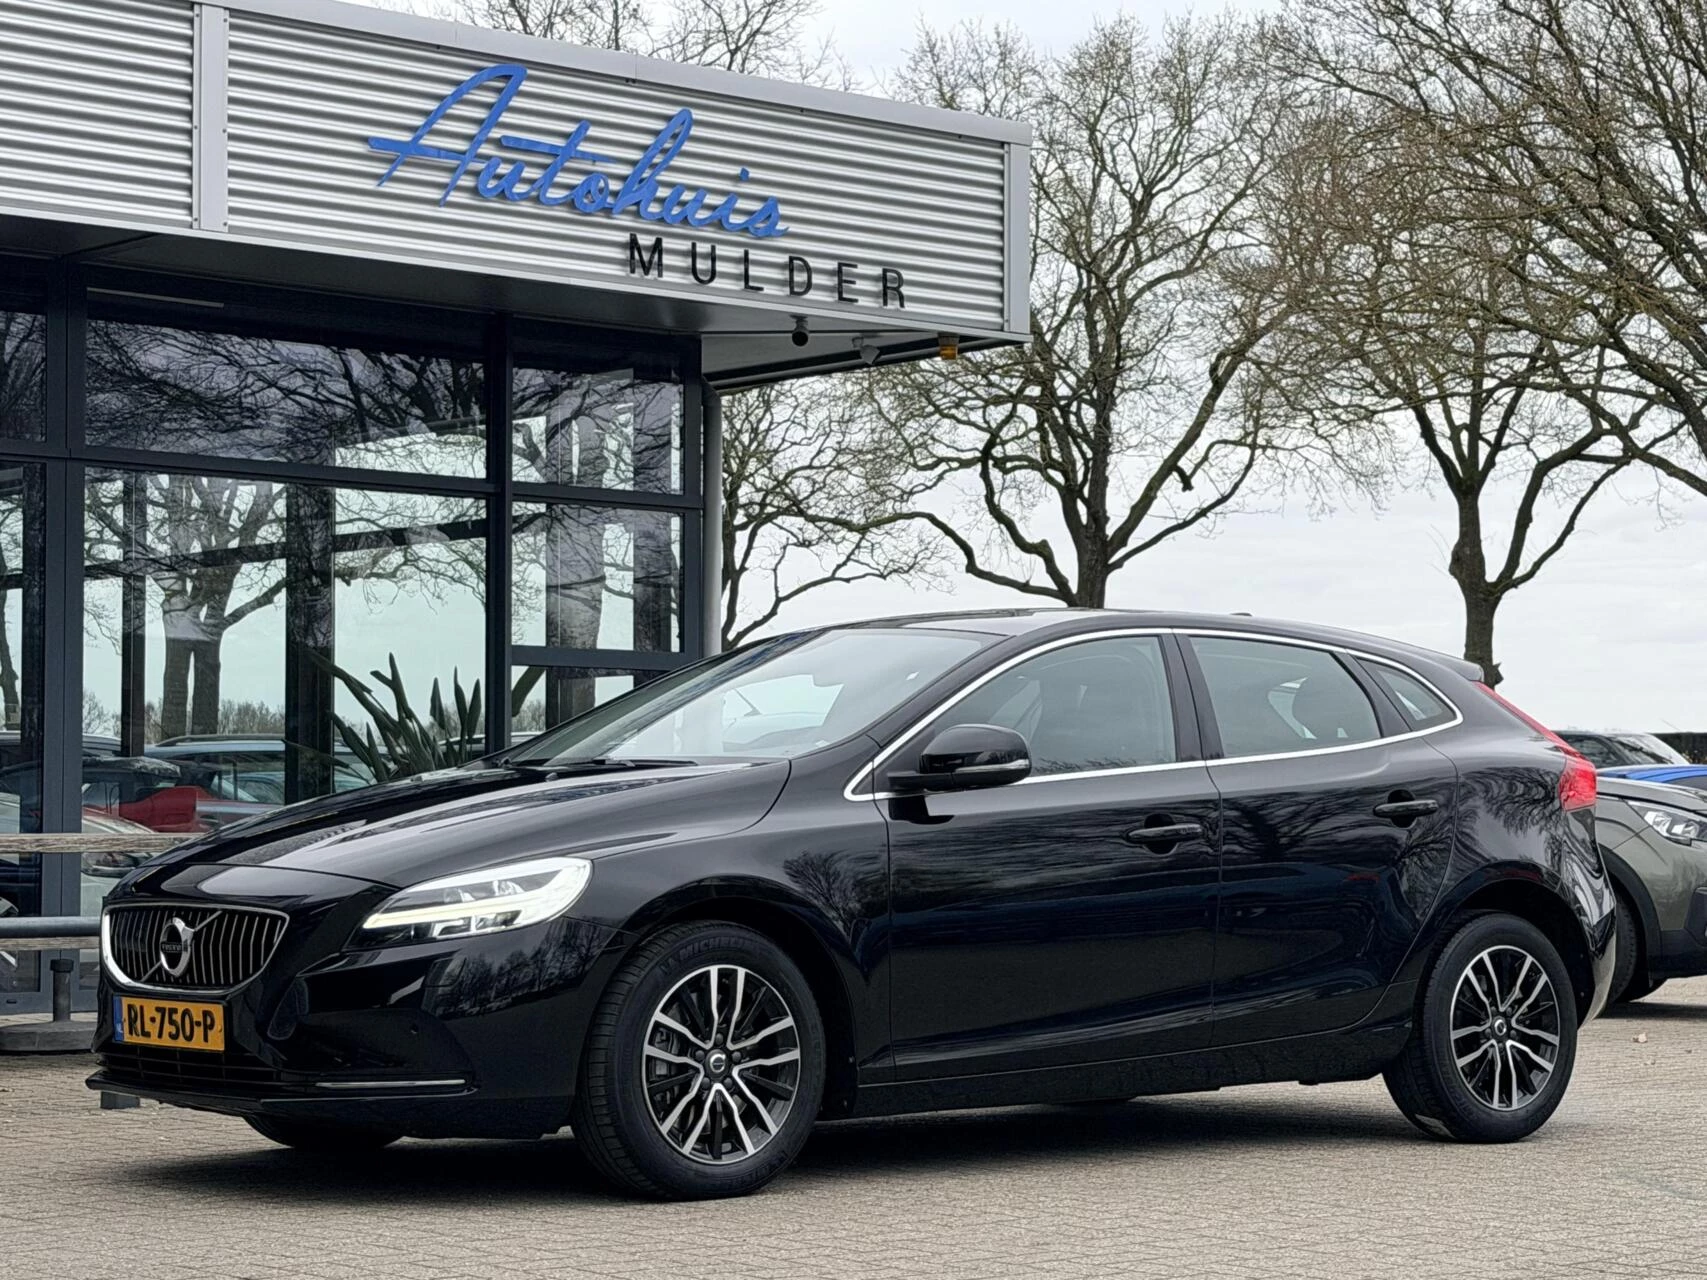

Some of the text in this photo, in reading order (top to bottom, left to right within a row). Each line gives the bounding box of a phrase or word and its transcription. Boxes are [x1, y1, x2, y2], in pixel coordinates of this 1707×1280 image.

[368, 64, 790, 238] Autohuis
[628, 232, 906, 309] MULDER
[127, 1003, 215, 1042] RL-750-P
